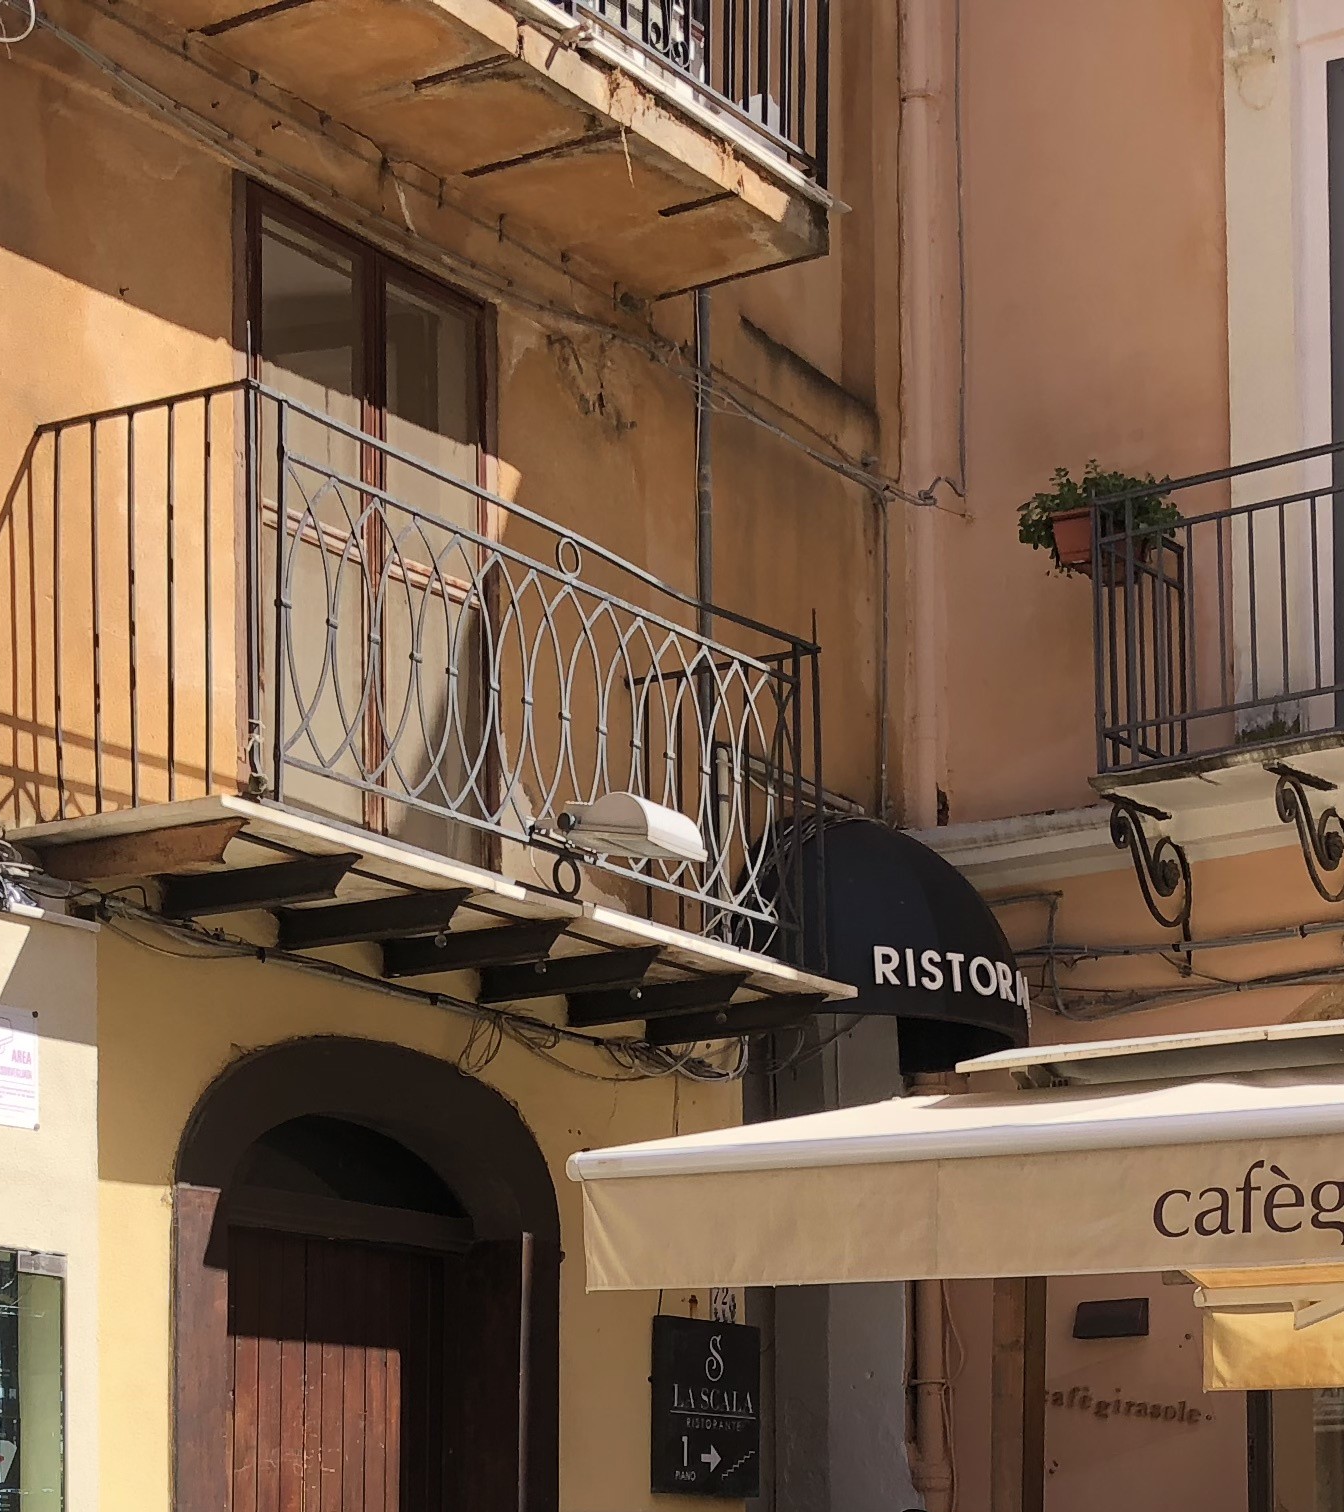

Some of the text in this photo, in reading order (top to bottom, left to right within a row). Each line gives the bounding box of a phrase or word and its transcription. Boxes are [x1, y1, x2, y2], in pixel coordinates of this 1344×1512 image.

[673, 1384, 754, 1414] LA SCALA
[686, 1418, 742, 1432] RISTORANTE
[682, 1435, 689, 1466] 1
[675, 1470, 697, 1482] PIANO
